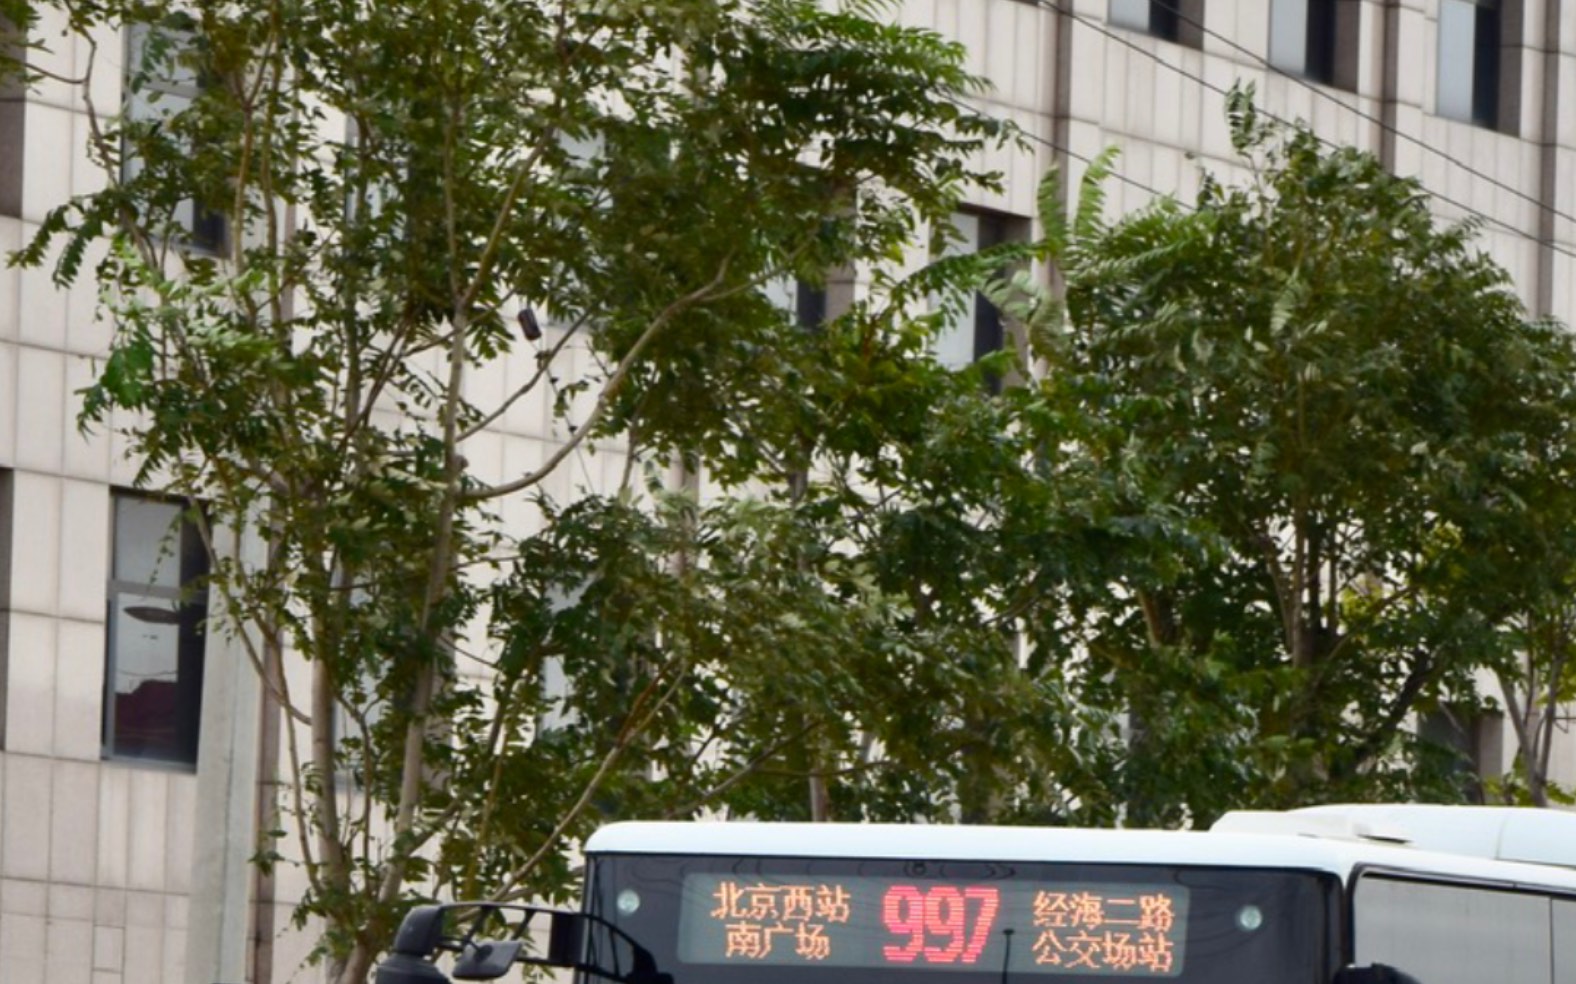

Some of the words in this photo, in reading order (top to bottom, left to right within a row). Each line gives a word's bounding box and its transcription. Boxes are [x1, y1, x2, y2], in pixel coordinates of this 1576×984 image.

[710, 881, 851, 924] 北京西站
[1032, 890, 1175, 932] 经海二路
[726, 921, 831, 959] 南广场
[881, 884, 1000, 964] 997
[1032, 930, 1174, 972] 公交场站
